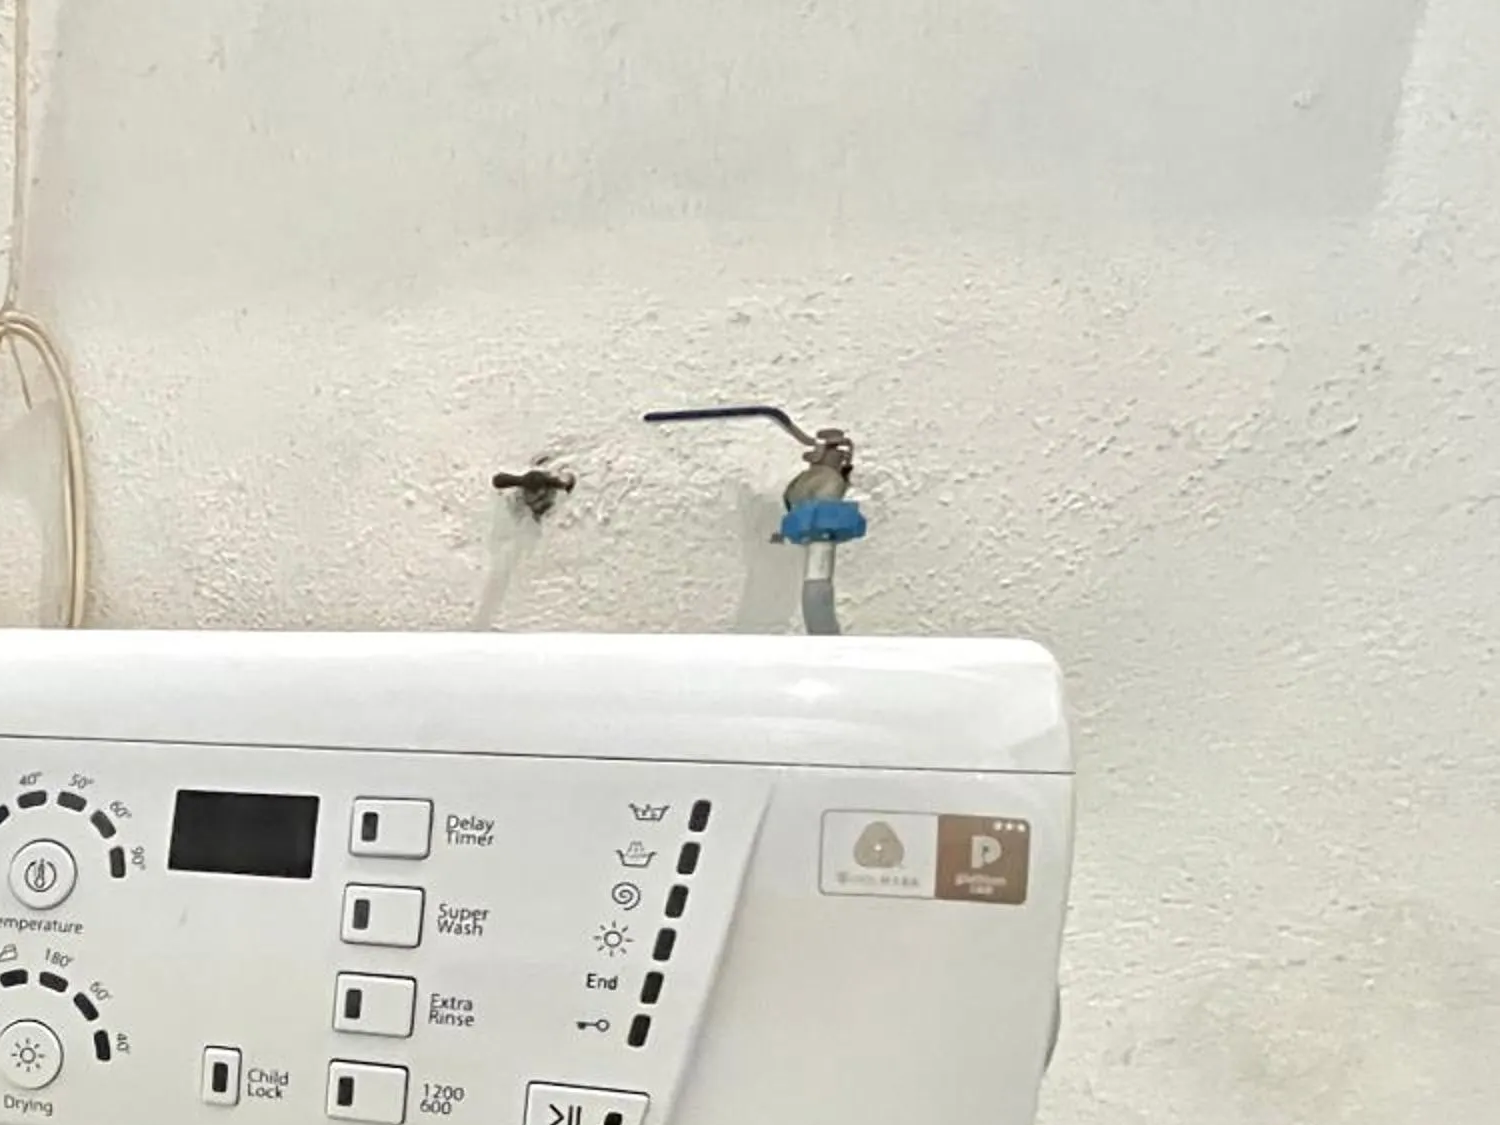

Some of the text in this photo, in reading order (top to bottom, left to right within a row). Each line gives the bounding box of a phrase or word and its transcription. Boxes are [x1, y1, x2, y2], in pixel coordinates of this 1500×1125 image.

[445, 813, 495, 835] Delay
[445, 831, 495, 848] Timer
[437, 903, 490, 922] Super
[436, 920, 484, 937] Wash
[585, 972, 618, 991] End
[429, 993, 475, 1012] Extra
[427, 1010, 475, 1027] Rinse
[247, 1068, 290, 1086] Child
[246, 1083, 284, 1099] Lock
[422, 1083, 466, 1101] 1200
[3, 1094, 54, 1117] Drying
[419, 1100, 453, 1116] 600
